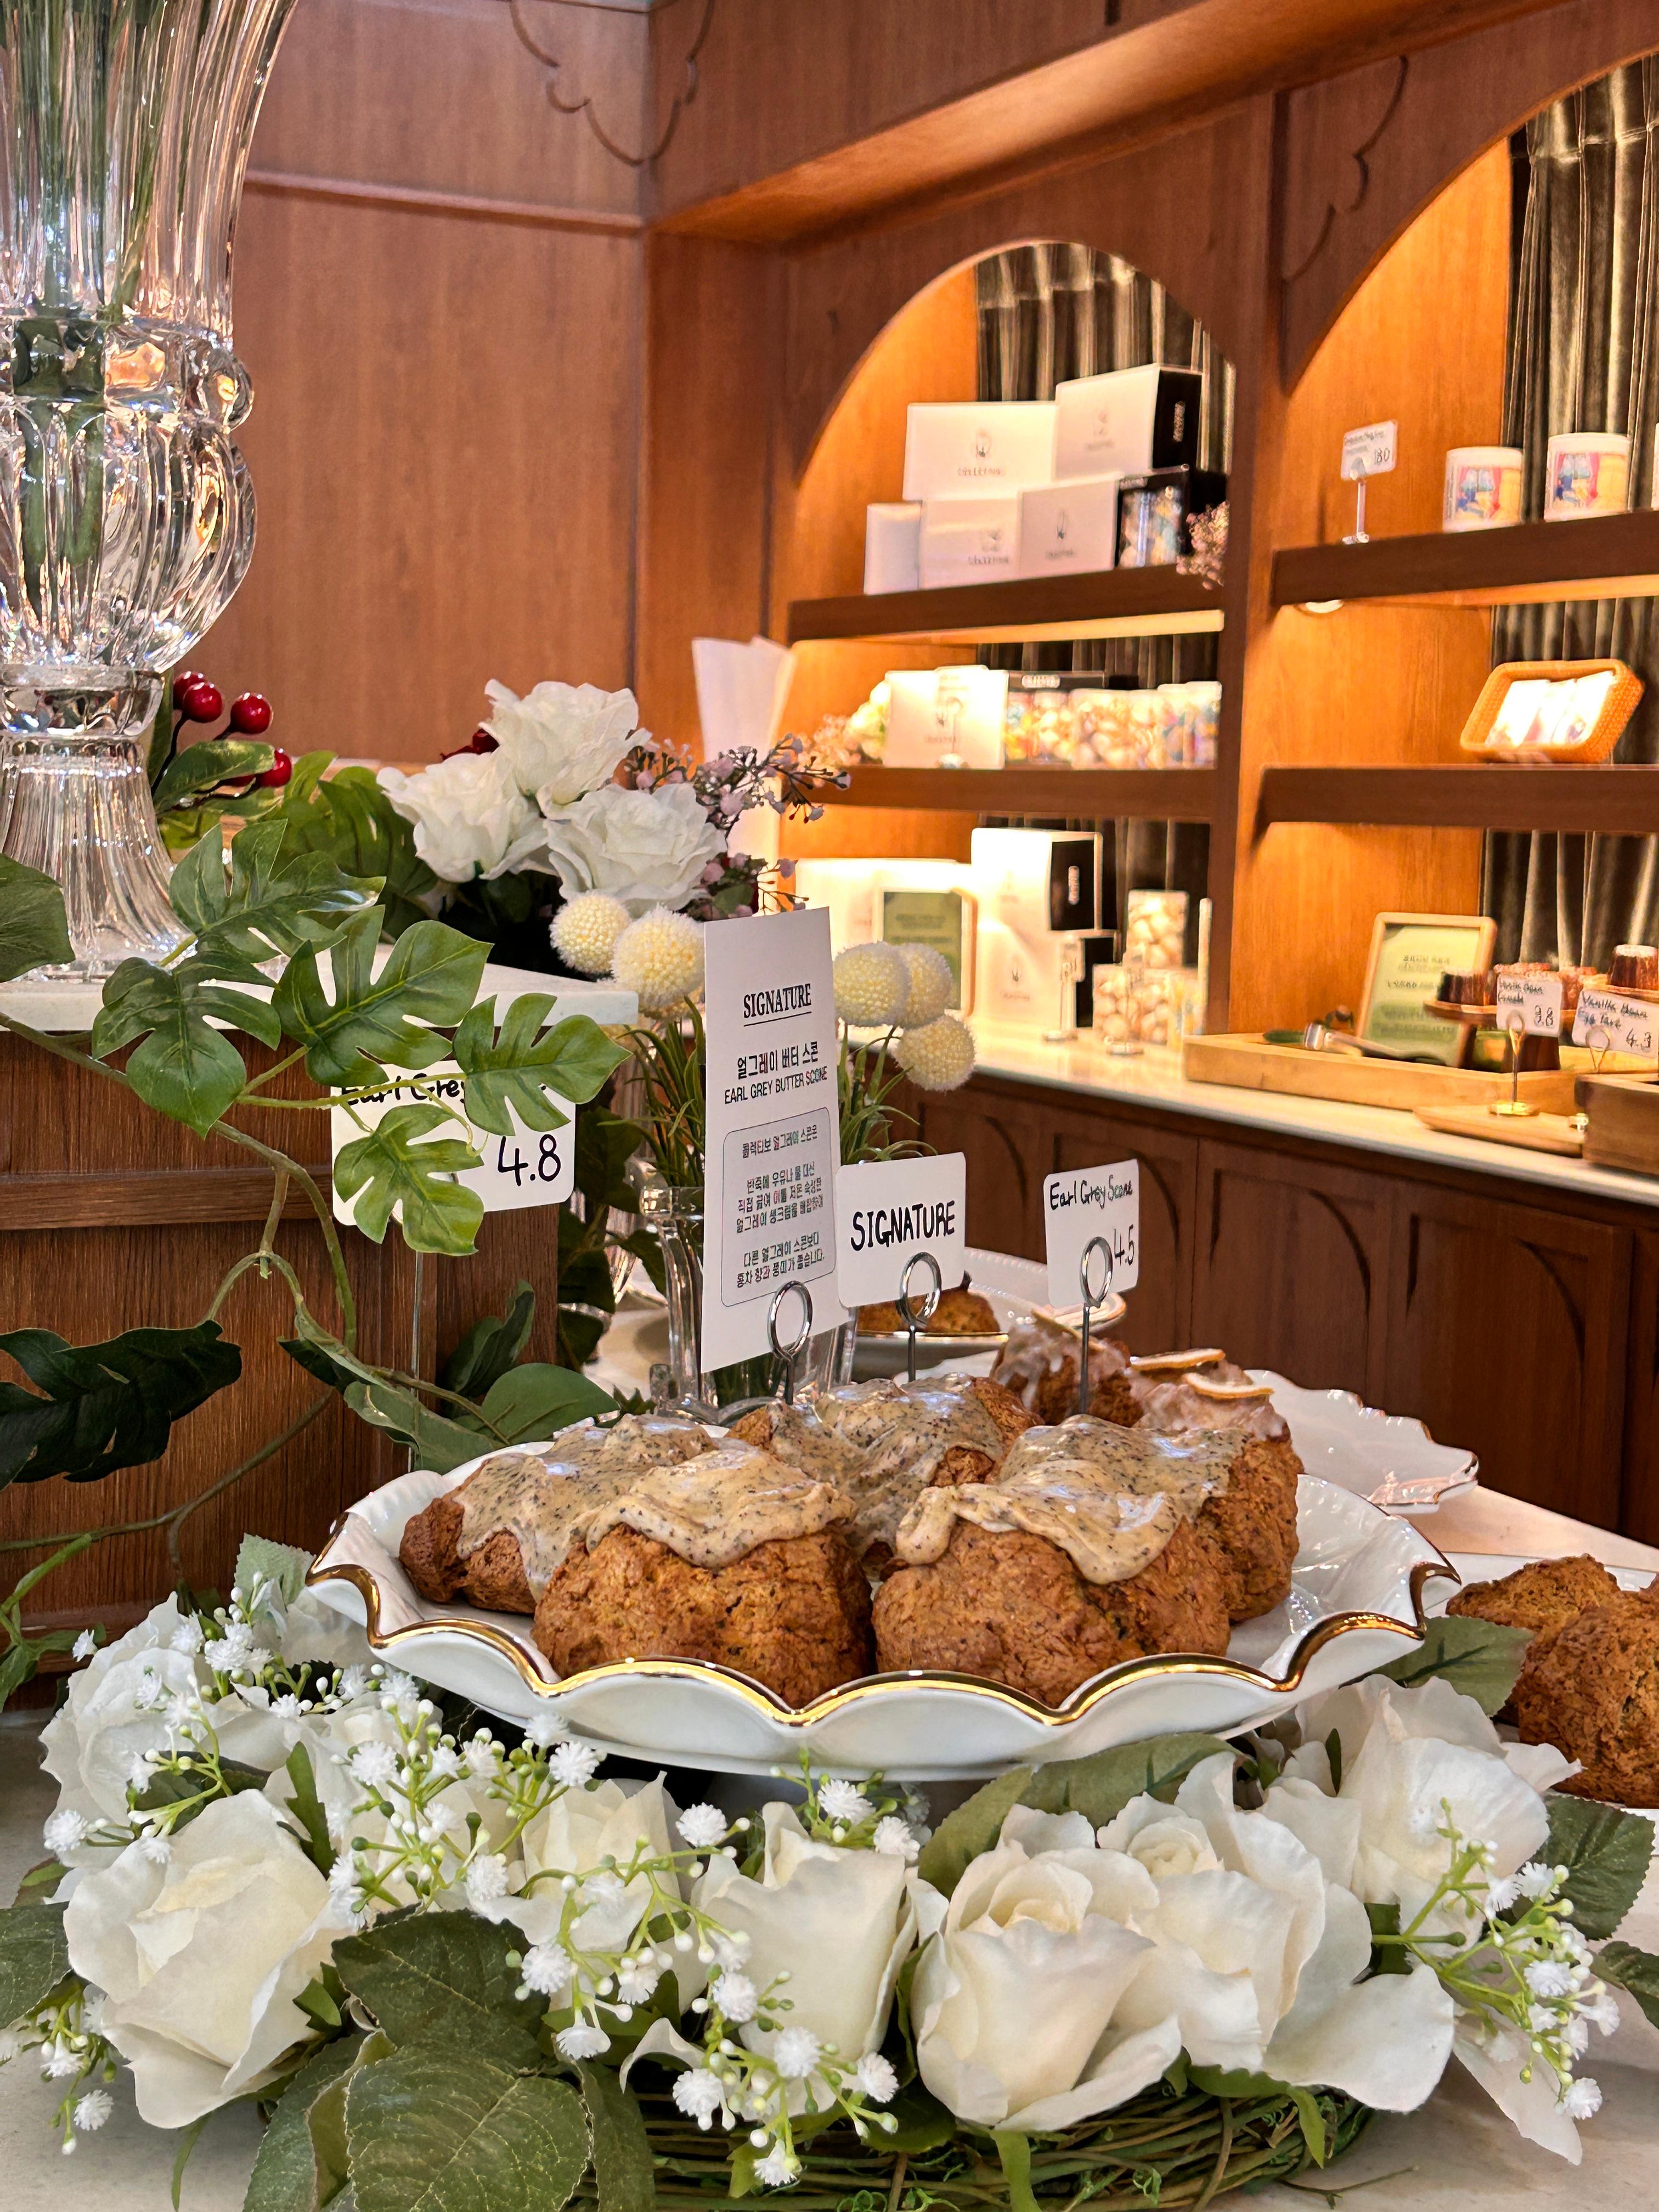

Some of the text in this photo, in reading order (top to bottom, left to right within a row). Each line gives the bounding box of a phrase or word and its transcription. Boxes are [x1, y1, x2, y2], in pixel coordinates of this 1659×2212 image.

[743, 983, 811, 1019] SIGNATURE
[737, 1041, 819, 1080] 얼그레이 버터 스콘
[725, 1066, 827, 1105] EARL GREY BUTTER SCONE
[773, 1130, 799, 1151] 얼그레이
[800, 1125, 817, 1143] 스콘은
[498, 1134, 561, 1187] 4.8
[747, 1175, 769, 1194] 반죽에
[772, 1168, 793, 1187] 우유나
[803, 1161, 815, 1177] 대신
[738, 1197, 753, 1214] 직접
[1050, 1180, 1077, 1210] Earl
[1080, 1180, 1106, 1210] Grey
[736, 1211, 767, 1233] 얼그레이
[769, 1202, 798, 1224] 생크림을
[850, 1200, 955, 1251] SIGNATURE
[744, 1232, 819, 1267] 다른 얼그레이 스콘보다
[1113, 1224, 1135, 1266] 4.5
[737, 1248, 825, 1288] 홍차 향과 풍미가 좋습니다.
